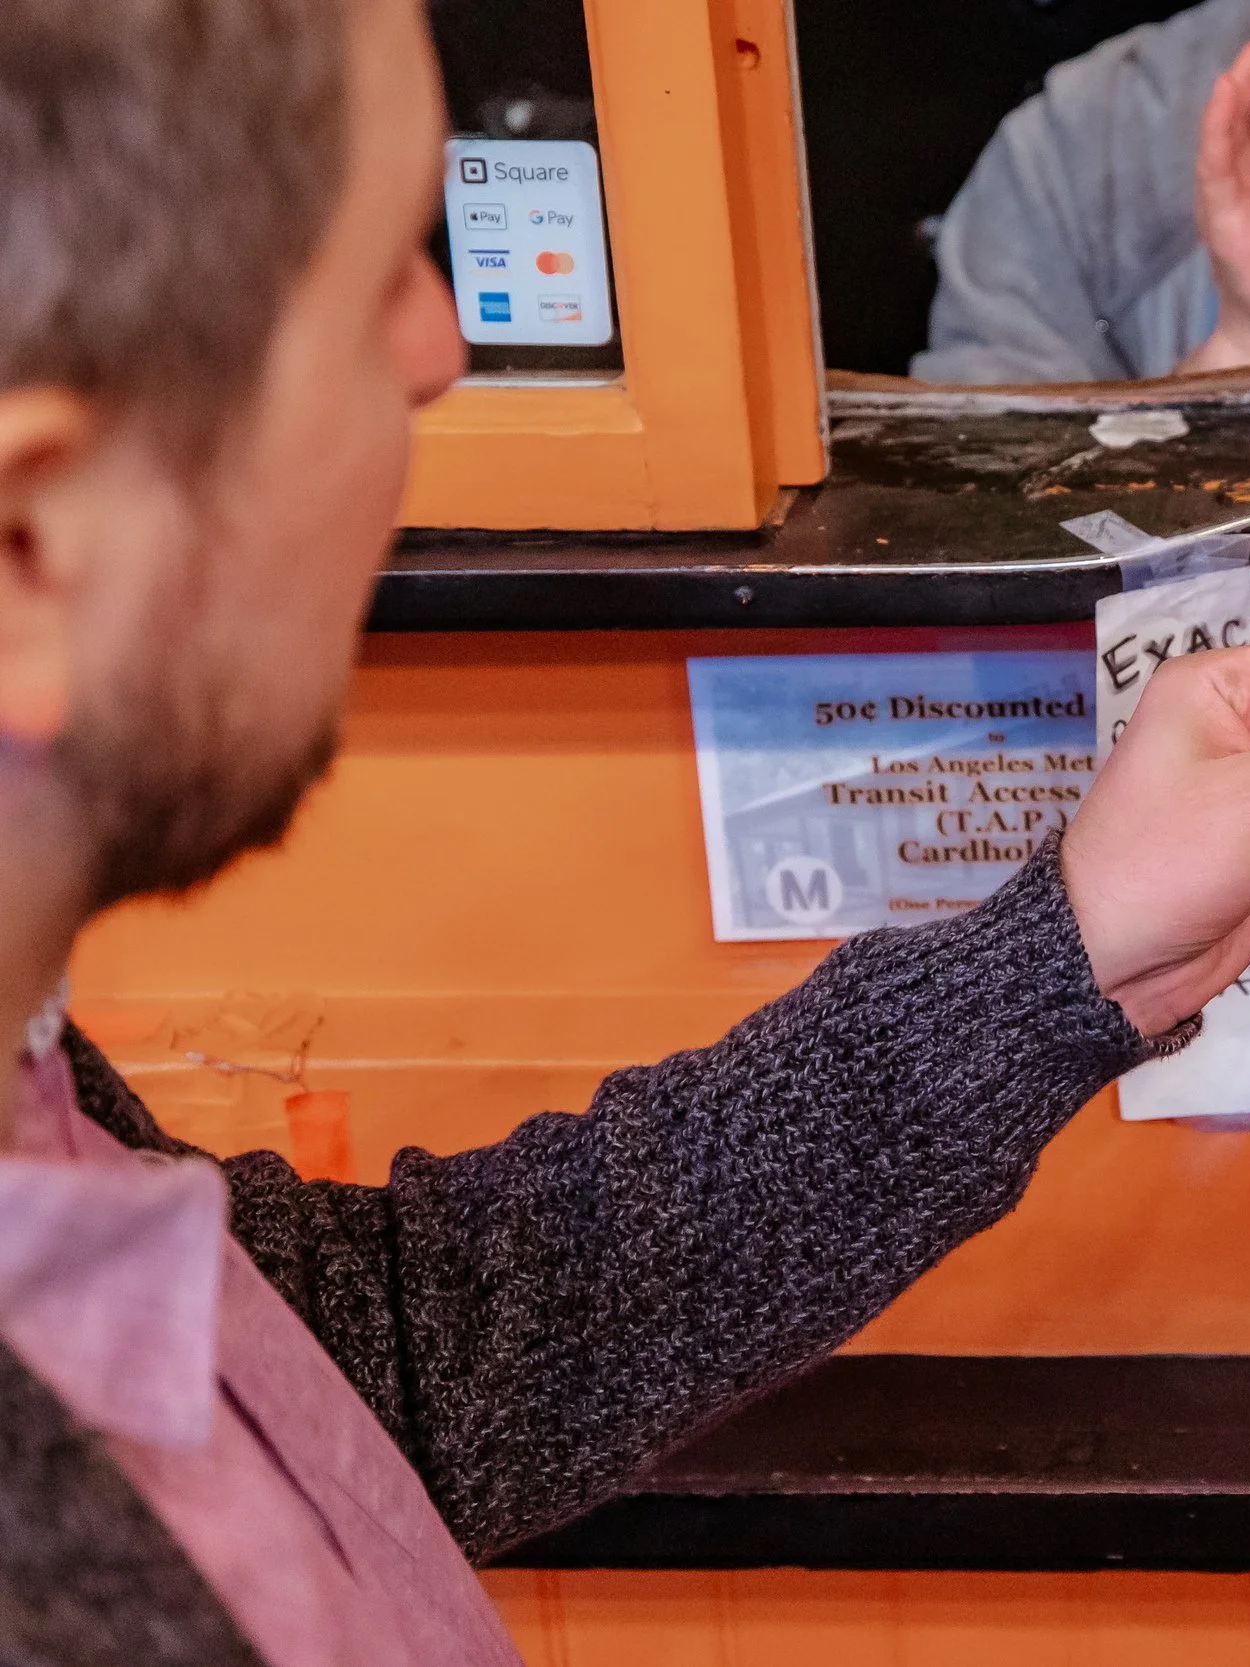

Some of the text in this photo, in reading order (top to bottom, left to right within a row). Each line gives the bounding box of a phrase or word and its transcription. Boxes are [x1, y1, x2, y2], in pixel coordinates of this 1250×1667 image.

[494, 162, 569, 184] Square
[480, 211, 501, 225] Pay
[547, 211, 574, 228] Pay
[476, 257, 506, 267] VISA
[814, 693, 1087, 726] 50¢ Discounted
[988, 731, 1006, 744] to
[870, 754, 1096, 777] Los Angeles Met
[823, 780, 1082, 804] Transit Access
[937, 808, 1067, 836] (T.A.P)
[898, 839, 1033, 863] Cardhol
